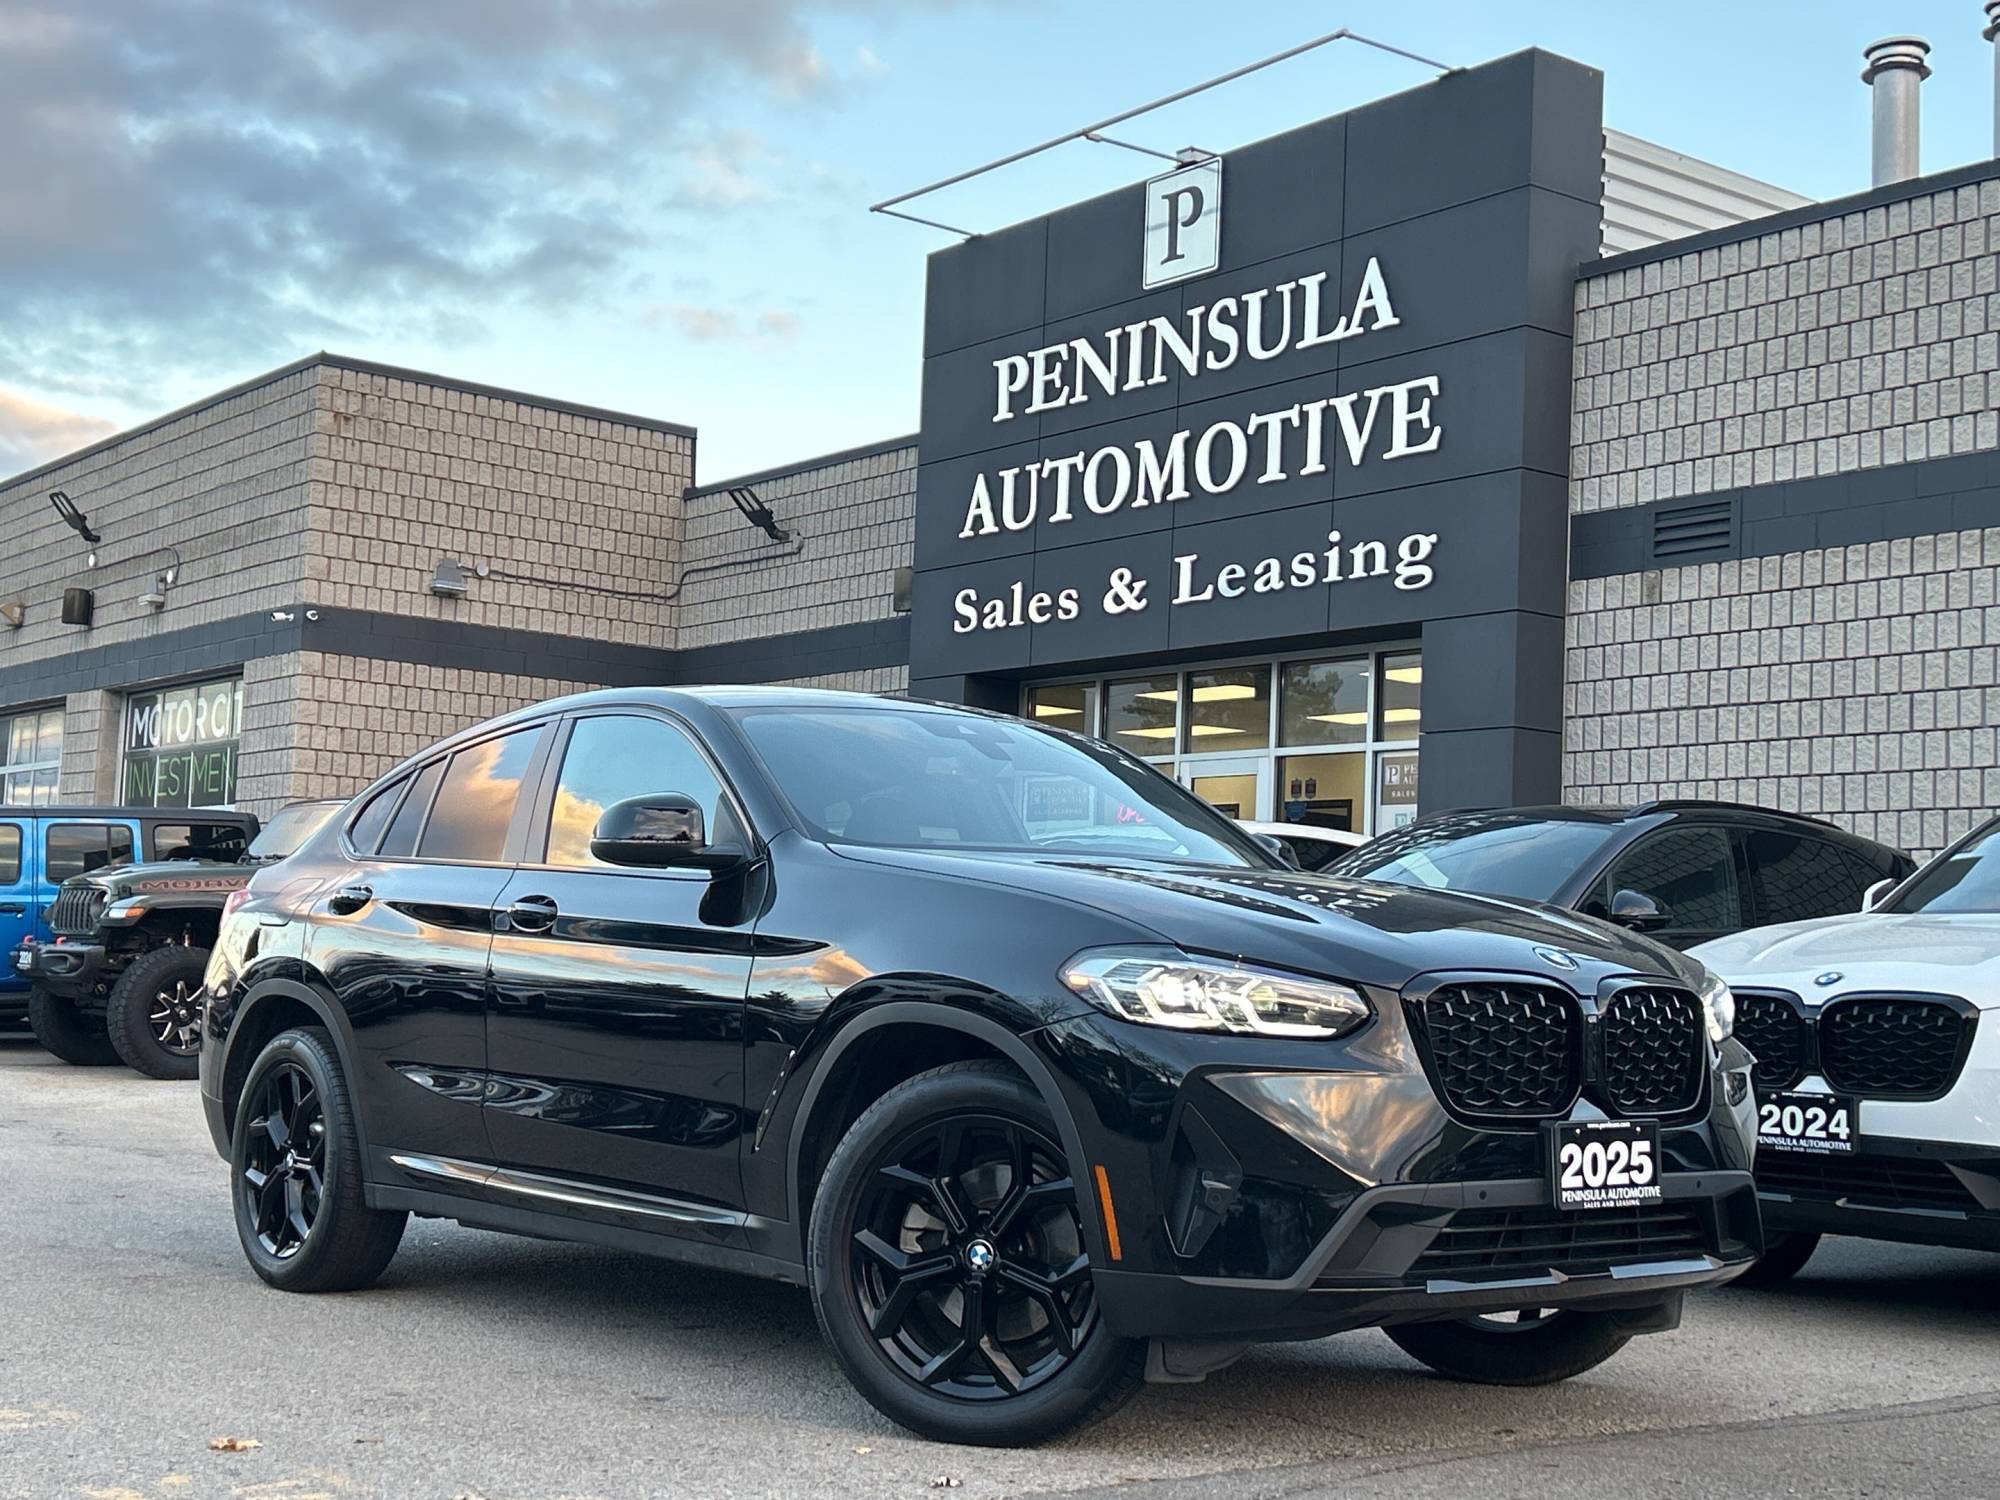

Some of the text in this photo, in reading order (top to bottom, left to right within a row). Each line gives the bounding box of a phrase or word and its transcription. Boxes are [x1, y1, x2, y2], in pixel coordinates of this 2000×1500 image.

[1160, 185, 1204, 265] P
[992, 256, 1401, 424] PENINSULA
[958, 375, 1442, 540] AUTOMOTIVE
[953, 529, 1439, 634] Sales & Leasing
[1760, 1103, 1850, 1140] 2024
[1799, 1138, 1852, 1151] AUTOMOTIVE
[1560, 1140, 1653, 1188] 2025
[1562, 1186, 1661, 1203] PENINSULA AUTOMOTIVE
[1584, 1199, 1640, 1209] SALES AND LEASING
